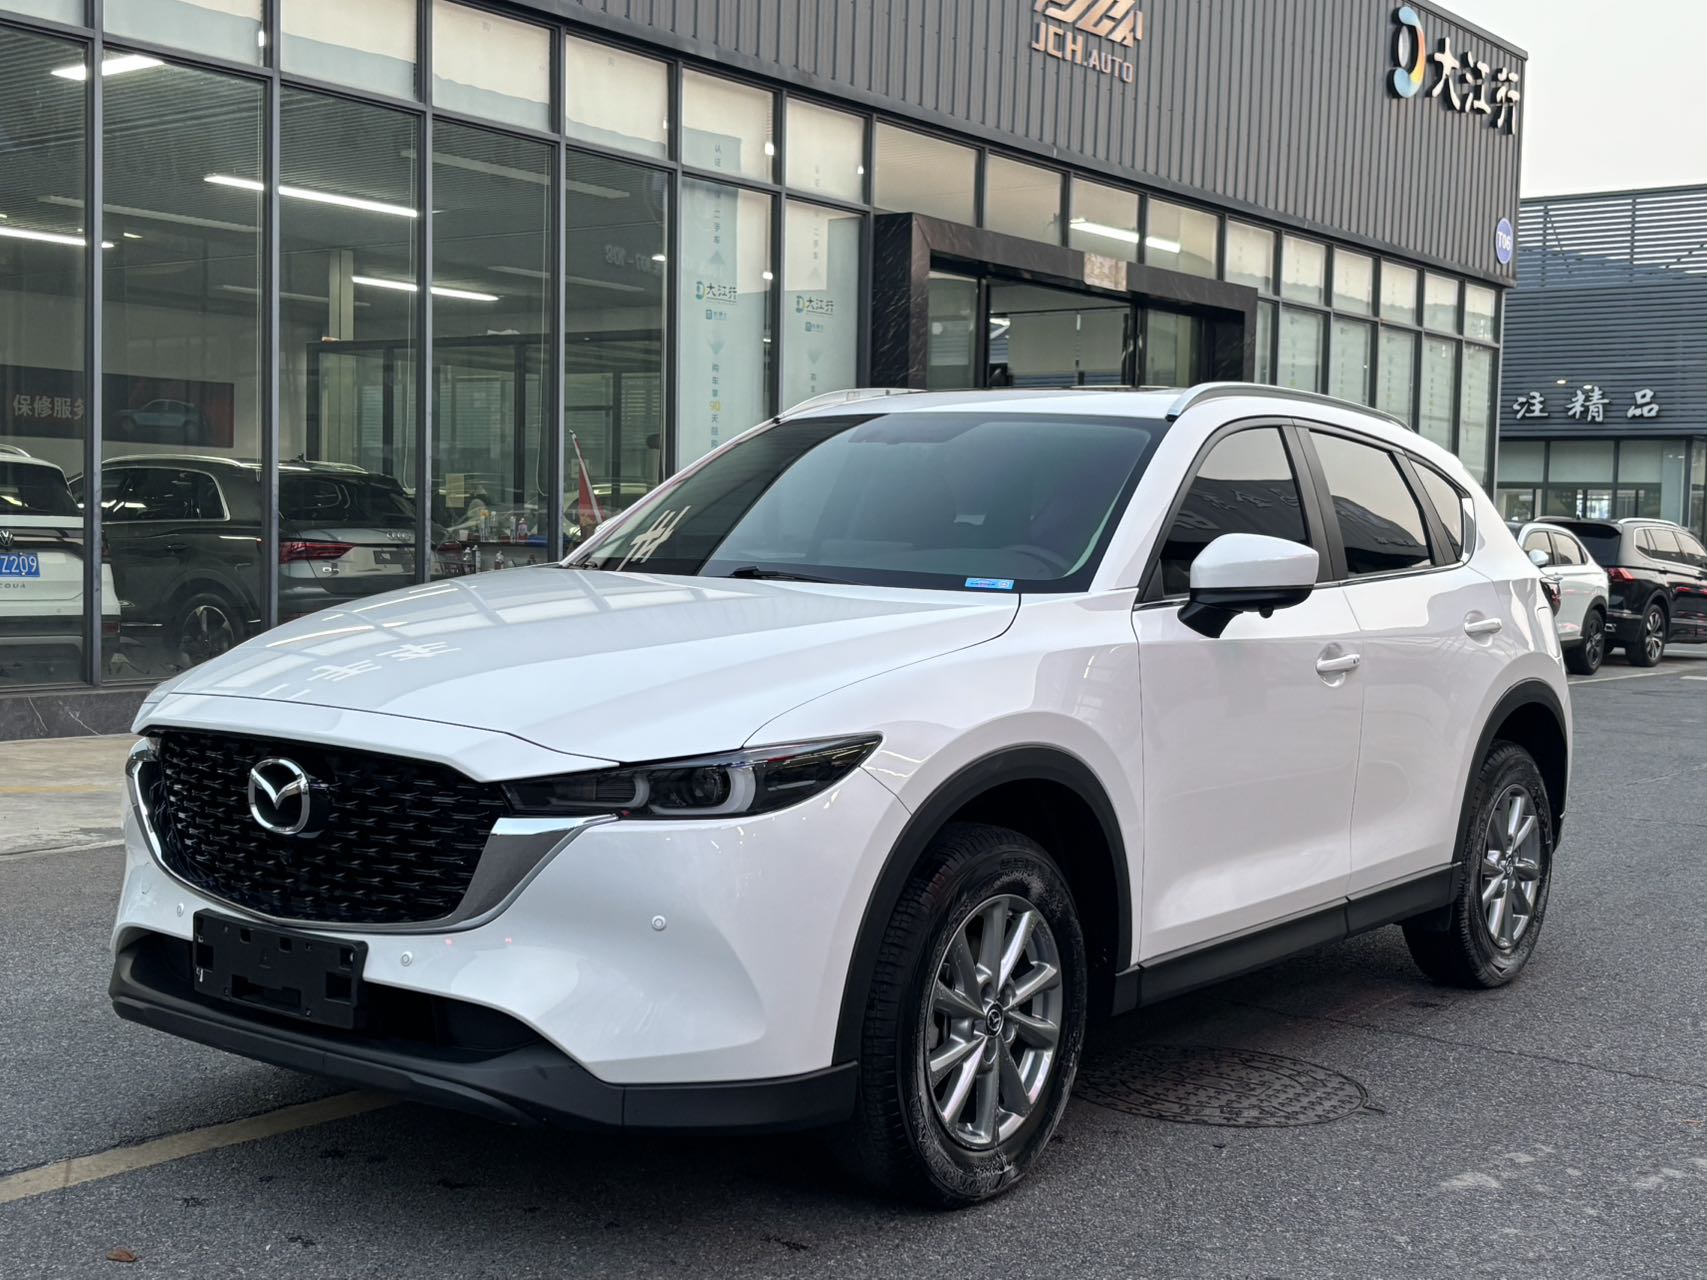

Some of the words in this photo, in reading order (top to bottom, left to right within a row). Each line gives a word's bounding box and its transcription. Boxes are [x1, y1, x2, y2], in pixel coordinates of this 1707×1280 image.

[1431, 36, 1521, 135] 大江行
[1497, 231, 1511, 251] T06
[706, 282, 737, 300] 大江行
[806, 296, 834, 313] 大江行
[1512, 386, 1660, 423] 注精品
